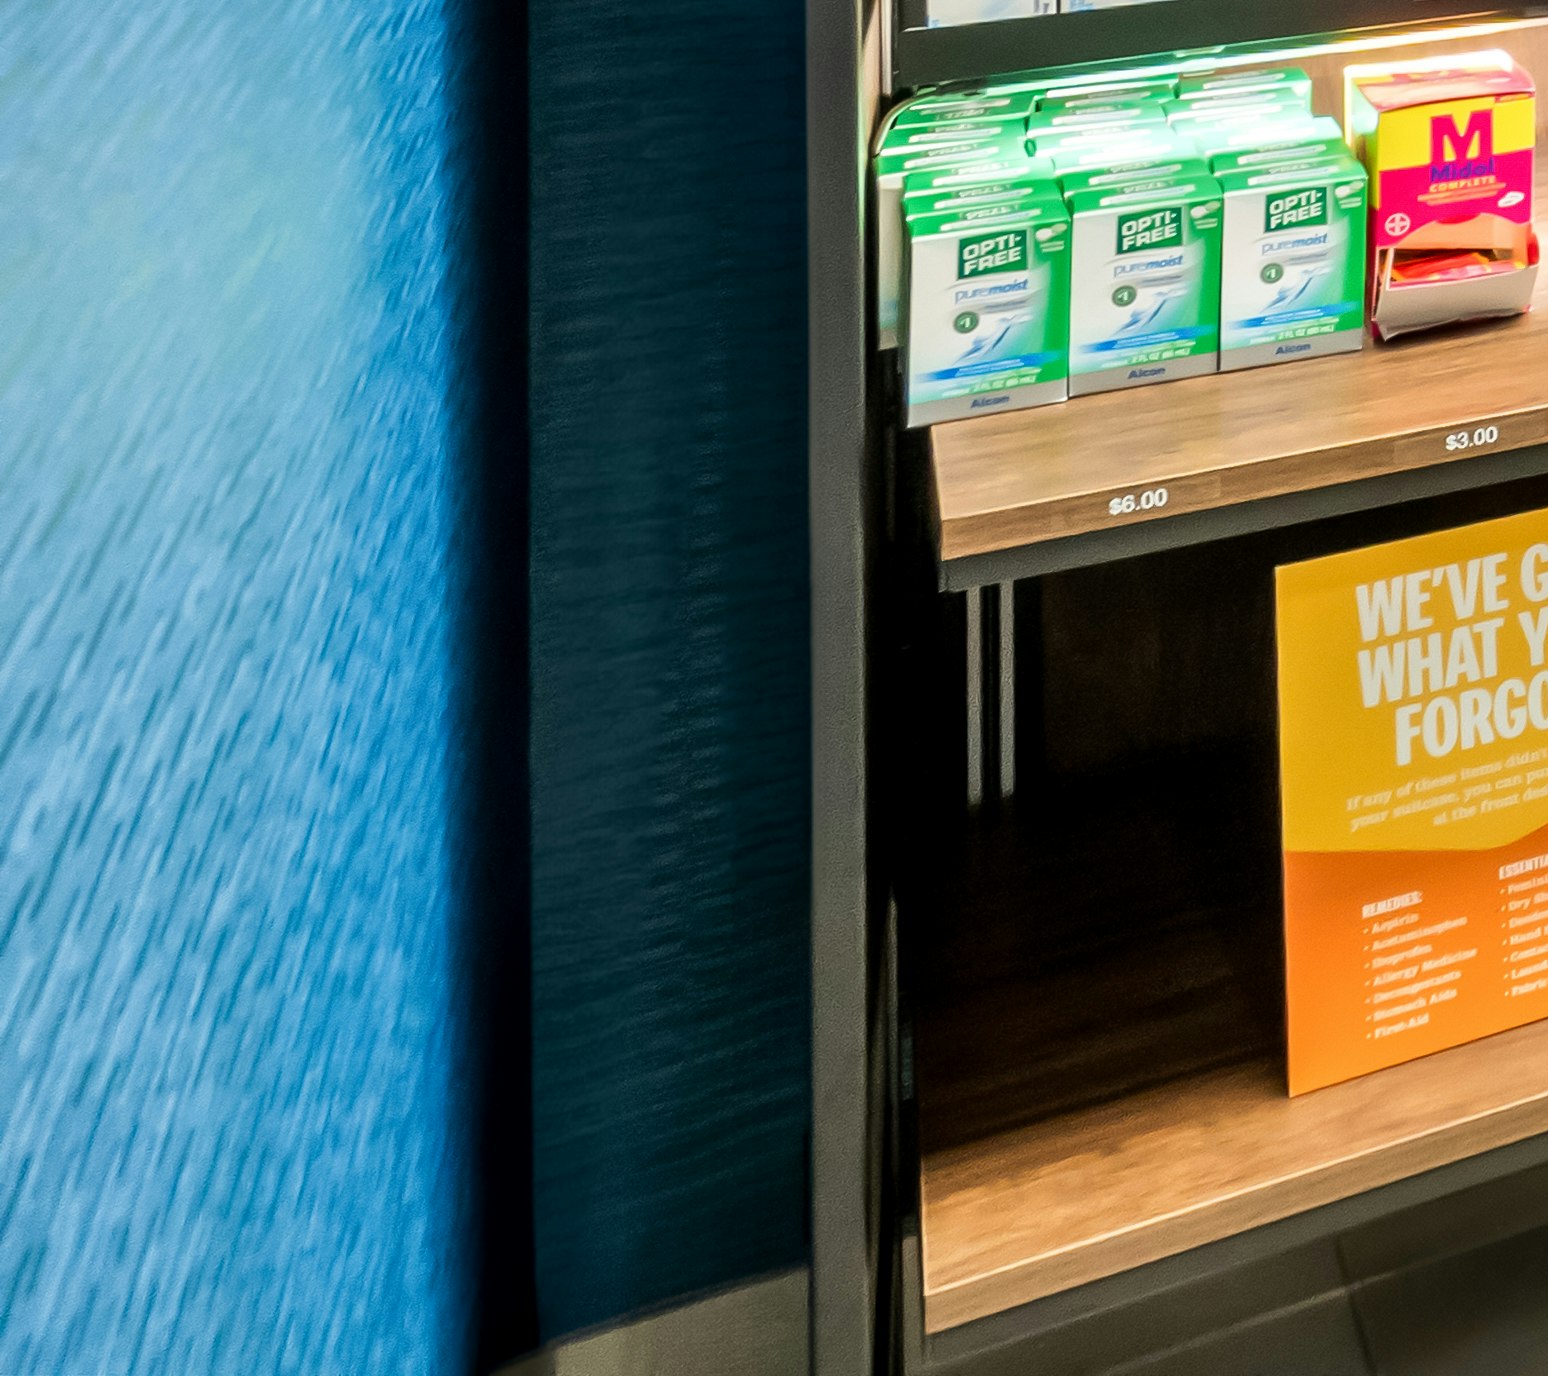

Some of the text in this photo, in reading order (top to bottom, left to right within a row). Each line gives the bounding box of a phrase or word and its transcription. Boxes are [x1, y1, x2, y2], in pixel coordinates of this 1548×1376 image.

[1430, 158, 1495, 181] Midol
[962, 232, 1023, 262] OPTI-
[964, 246, 1023, 276] FREE
[1445, 426, 1499, 451] $3.00
[1108, 488, 1168, 516] $6.00
[1356, 553, 1509, 642] WE'VE
[1358, 618, 1503, 708] WHAT
[1396, 784, 1412, 797] of
[1415, 774, 1456, 793] these
[1460, 762, 1502, 780] items
[1350, 812, 1389, 832] your
[1464, 784, 1490, 802] you
[1495, 774, 1522, 788] can
[1450, 805, 1476, 820] the
[1480, 794, 1520, 814] front
